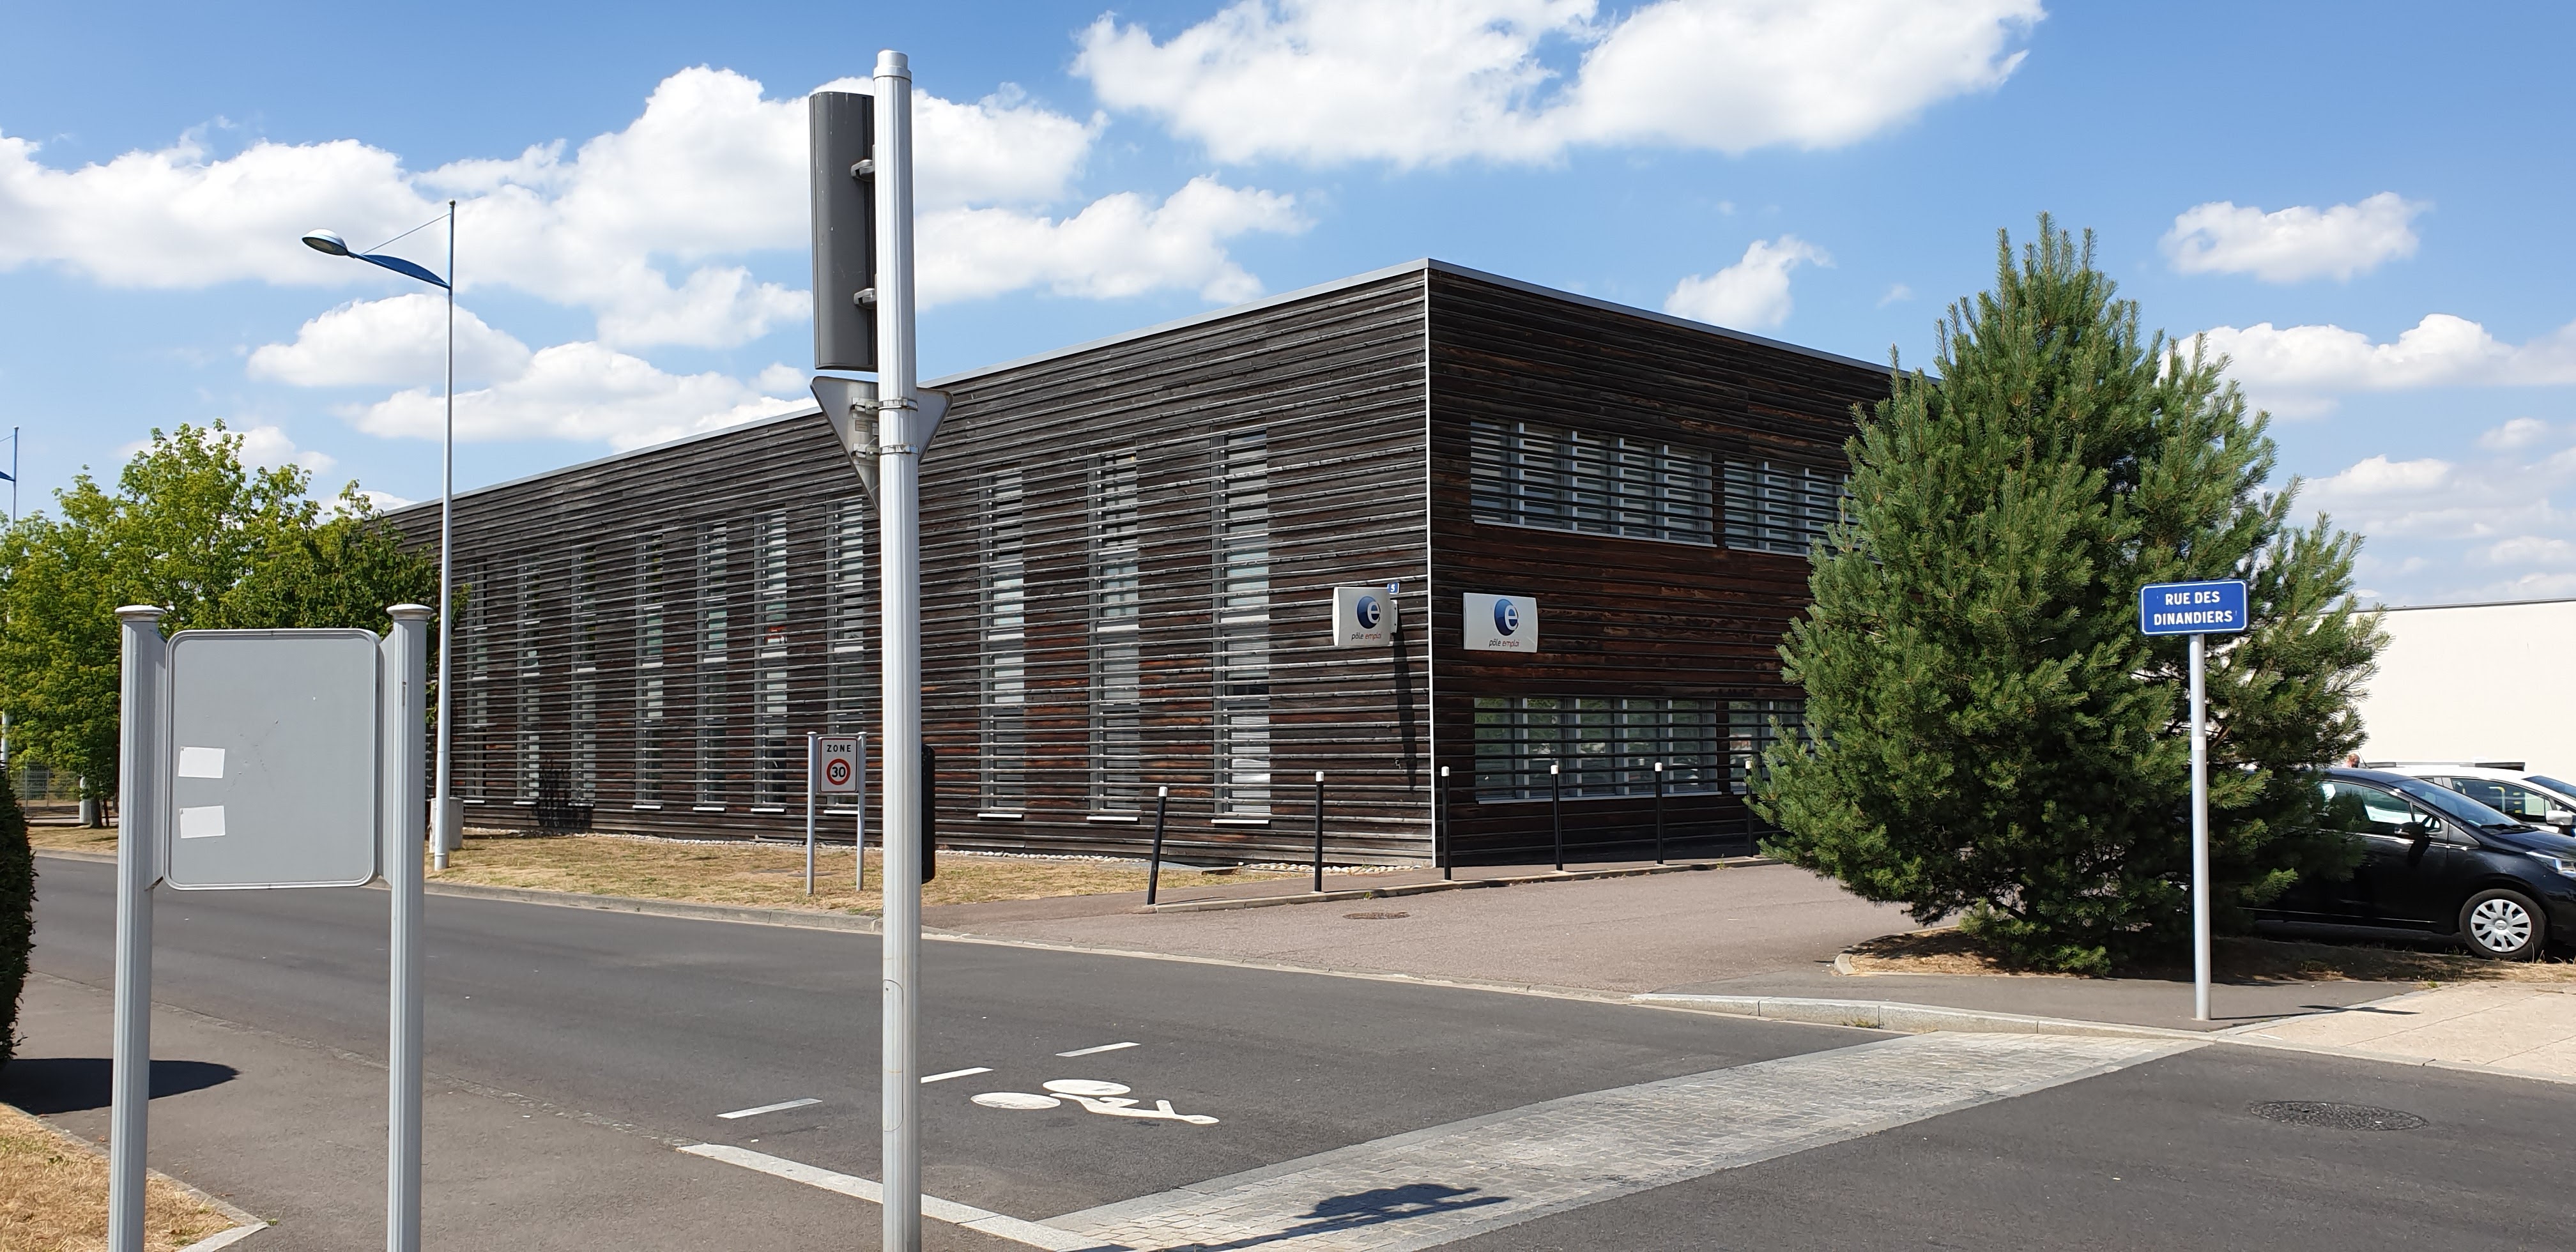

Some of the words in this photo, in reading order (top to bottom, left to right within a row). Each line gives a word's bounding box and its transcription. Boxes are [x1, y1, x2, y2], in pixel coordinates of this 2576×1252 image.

[1390, 584, 1395, 592] 5
[2165, 592, 2191, 606] RUE
[2195, 591, 2220, 604] DES
[2154, 610, 2233, 626] DINANDIERS
[1351, 632, 1364, 641] pôle
[1365, 632, 1382, 641] emploi
[1489, 639, 1501, 648] pôle
[1502, 639, 1520, 649] emploi
[827, 744, 852, 752] ZONE
[831, 767, 846, 777] 30
